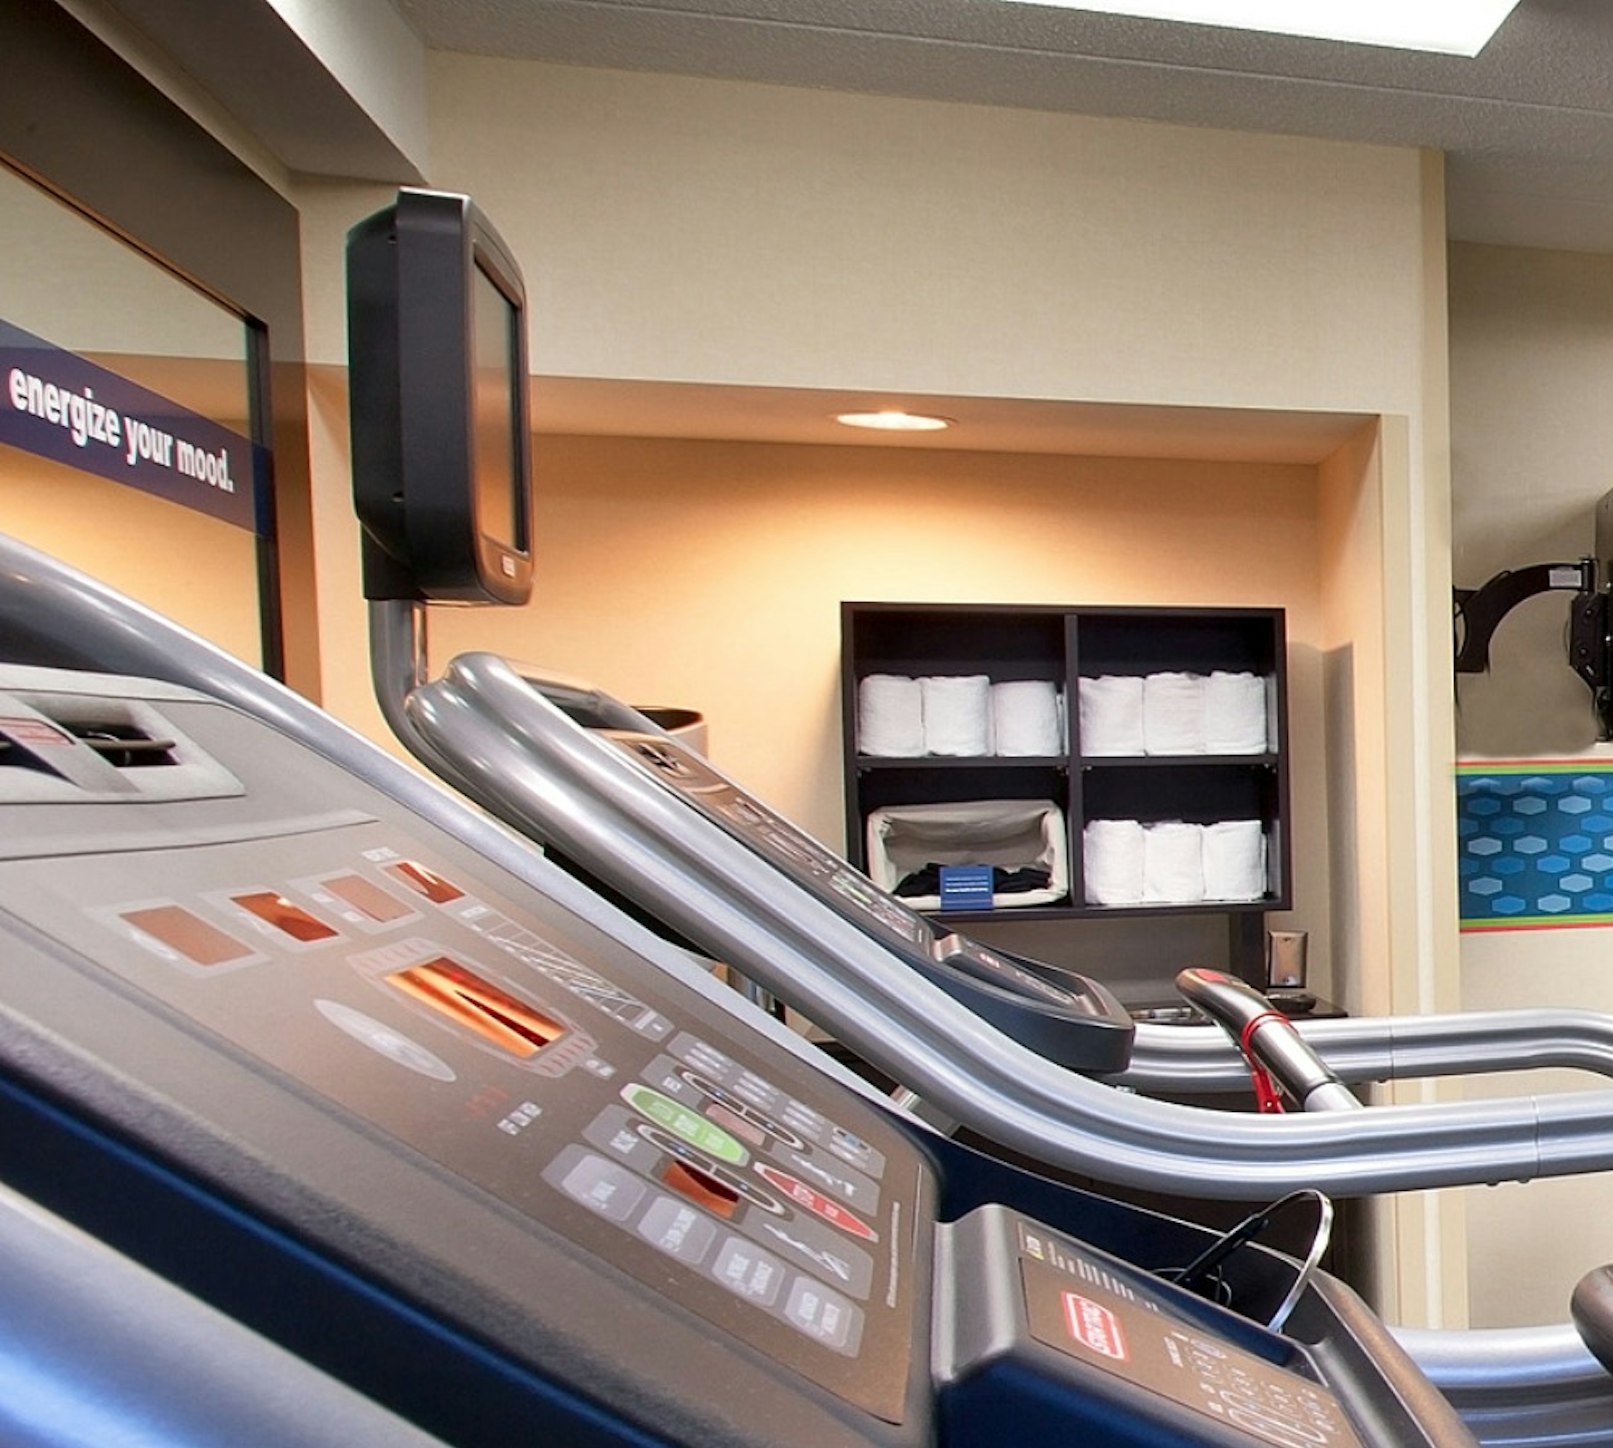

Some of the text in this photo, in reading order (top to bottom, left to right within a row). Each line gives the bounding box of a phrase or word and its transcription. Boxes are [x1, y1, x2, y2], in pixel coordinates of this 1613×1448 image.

[9, 367, 236, 493] energize your mood.
